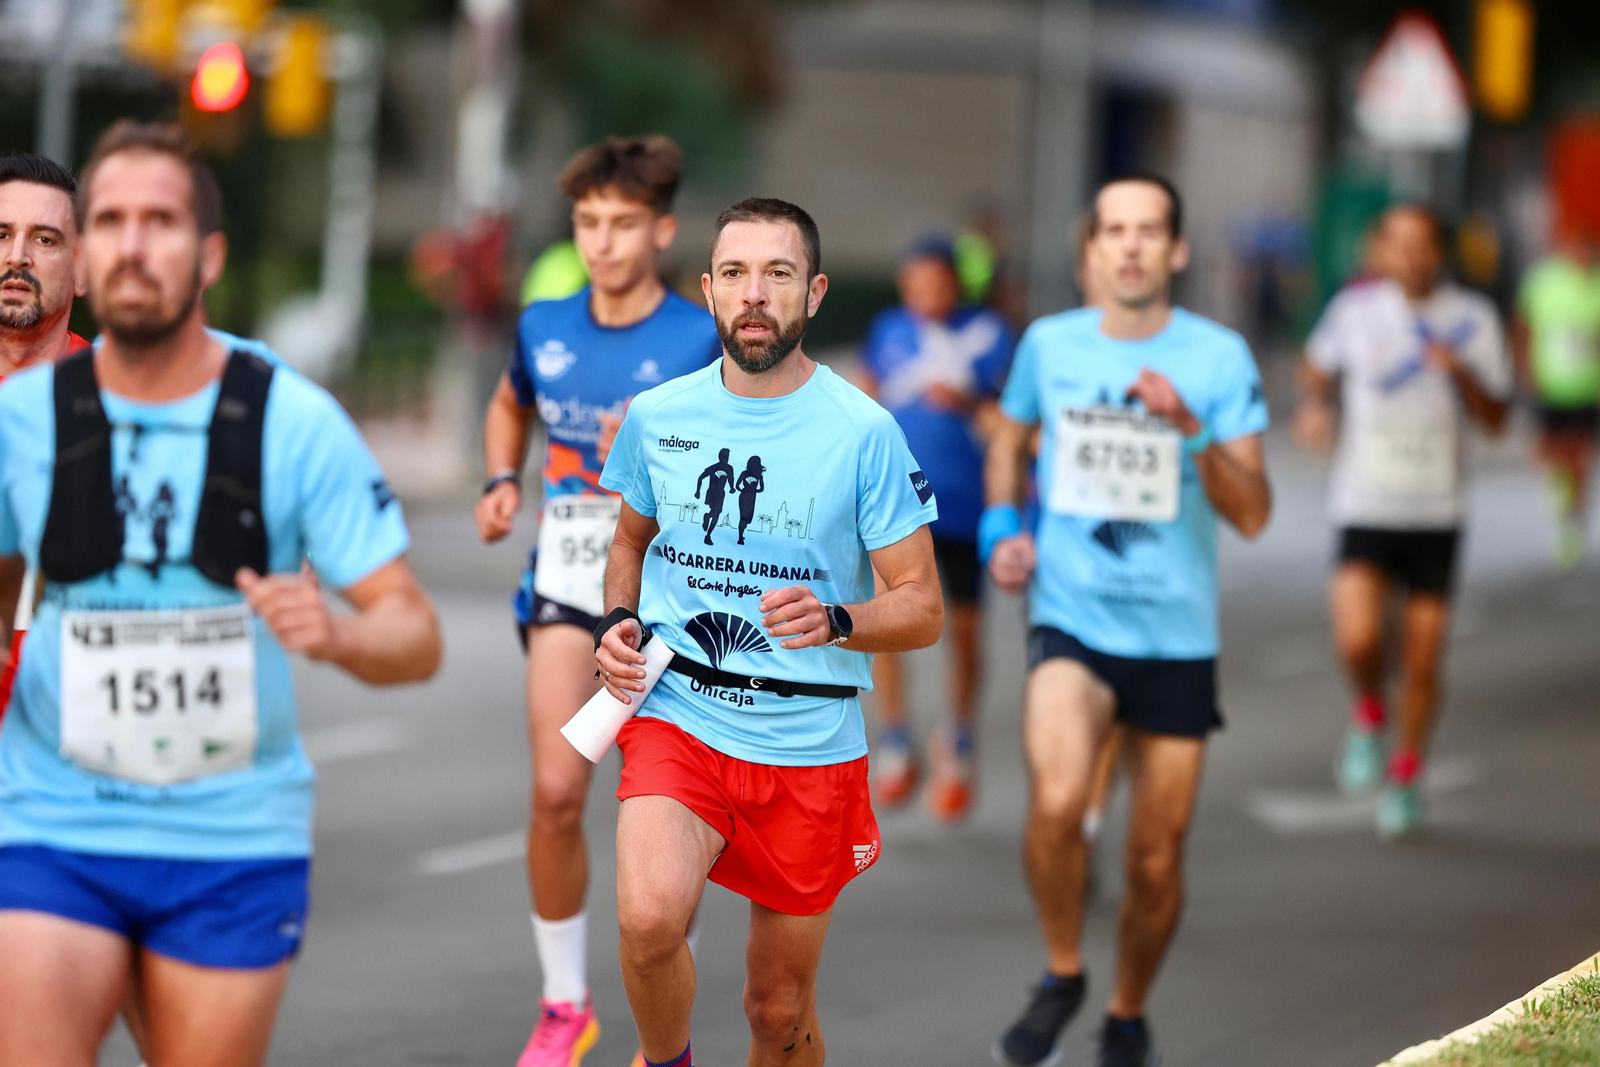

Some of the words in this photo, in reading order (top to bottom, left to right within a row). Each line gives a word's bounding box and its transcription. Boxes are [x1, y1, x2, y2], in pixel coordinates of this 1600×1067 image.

[659, 435, 700, 451] málaga
[663, 544, 676, 564] 43
[677, 552, 746, 574] CARRERA
[749, 561, 811, 581] URBANA
[687, 575, 697, 588] El
[697, 577, 724, 592] Corte
[102, 668, 222, 714] 1514
[690, 678, 754, 707] Unicaja
[857, 840, 878, 873] adidas
